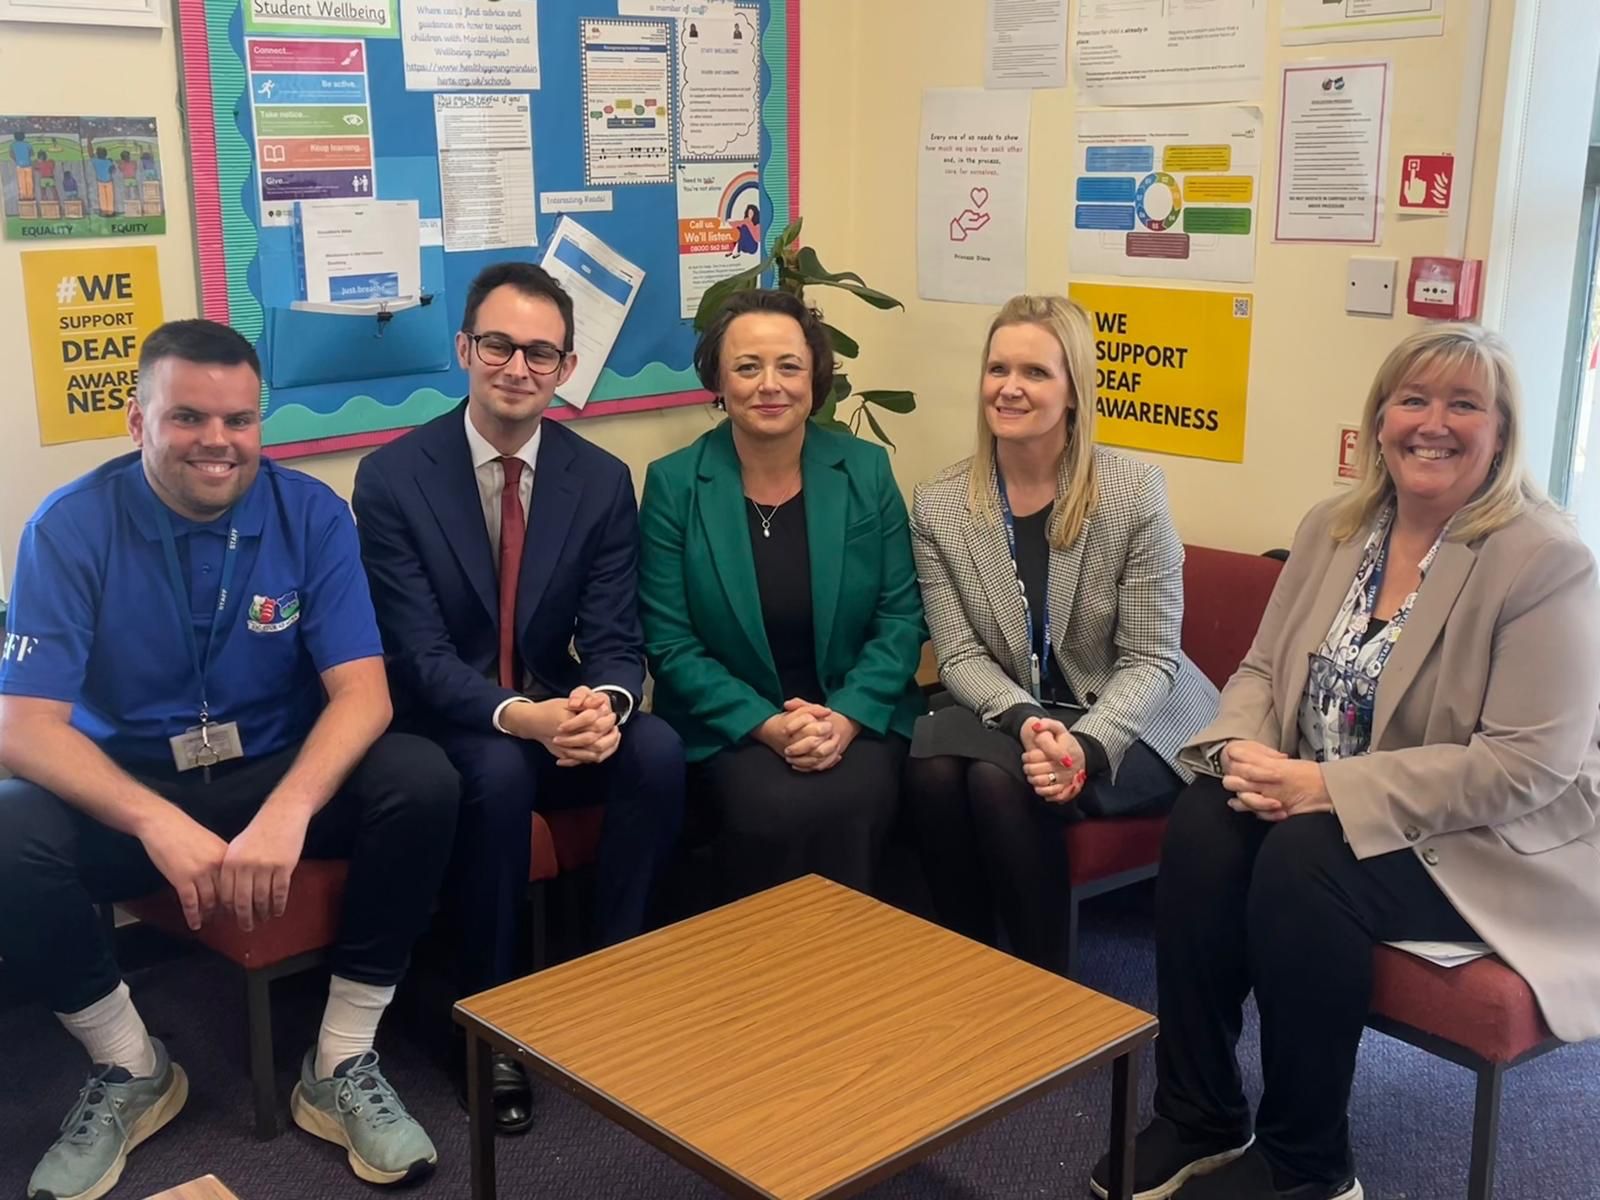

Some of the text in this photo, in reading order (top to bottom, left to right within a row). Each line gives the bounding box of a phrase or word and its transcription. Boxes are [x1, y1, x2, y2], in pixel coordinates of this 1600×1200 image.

[254, 0, 386, 25] Student Wellbeing
[464, 7, 480, 18] find
[507, 8, 522, 17] and
[466, 21, 483, 30] how
[485, 22, 493, 30] to
[494, 23, 522, 33] support
[410, 33, 530, 44] children with Mental Health and
[434, 47, 510, 59] Wellbeing struggles?
[321, 80, 331, 88] Be
[260, 110, 278, 118] Take
[930, 132, 946, 142] Every
[959, 133, 966, 141] of
[1003, 133, 1018, 141] show
[310, 144, 329, 153] Keep
[980, 145, 988, 153] for
[547, 196, 583, 205] Interesting
[111, 223, 149, 234] EQUITY
[689, 220, 703, 229] Call
[22, 225, 73, 237] EQUALITY
[684, 232, 707, 243] We'll
[56, 273, 133, 304] #WE
[59, 312, 134, 330] SUPPORT
[1095, 311, 1127, 334] WE
[62, 335, 136, 363] DEAF
[1095, 340, 1188, 369] SUPPORT
[66, 369, 138, 391] AWARE
[1096, 396, 1218, 431] AWARENESS
